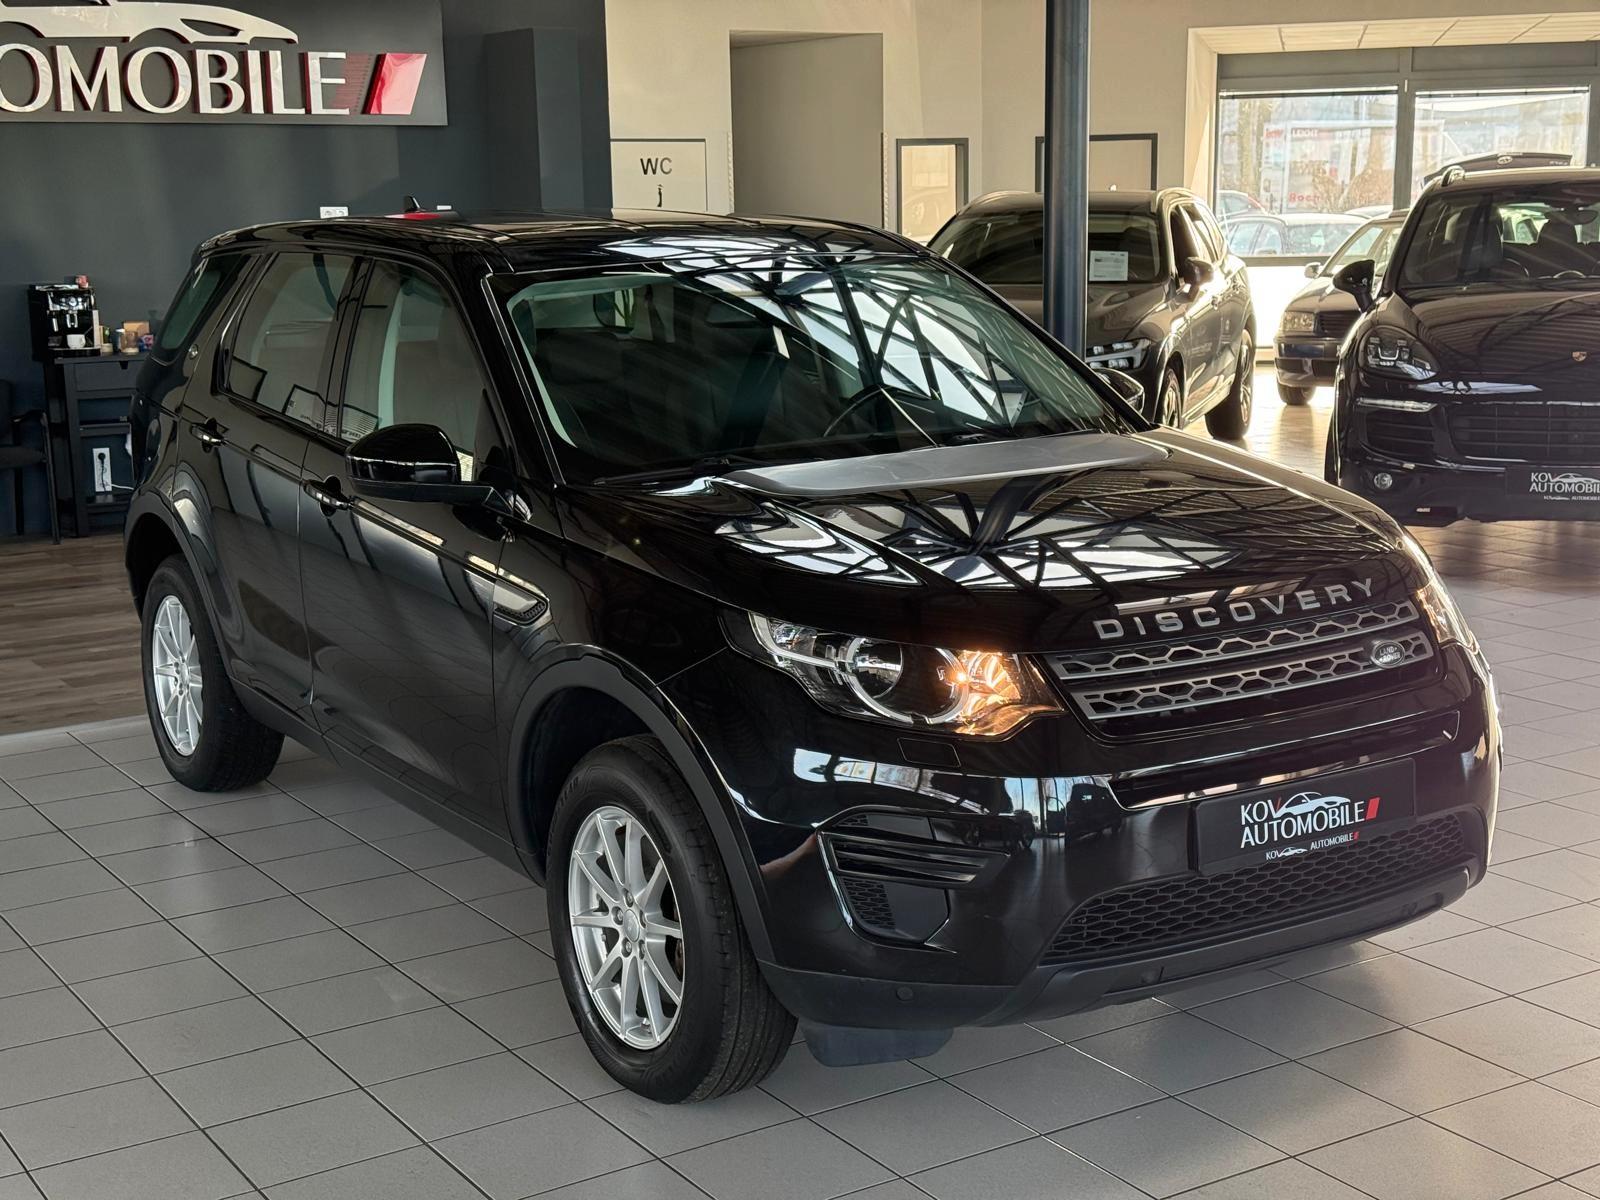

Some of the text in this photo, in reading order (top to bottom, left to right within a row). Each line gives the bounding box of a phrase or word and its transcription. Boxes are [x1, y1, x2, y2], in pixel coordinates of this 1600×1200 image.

[640, 157, 672, 175] WC
[1094, 578, 1374, 640] DISCOVERY
[1240, 800, 1365, 849] AUTOMOBILE
[1241, 797, 1281, 825] KOV
[1266, 832, 1353, 860] KOV AUTOMOBILE
